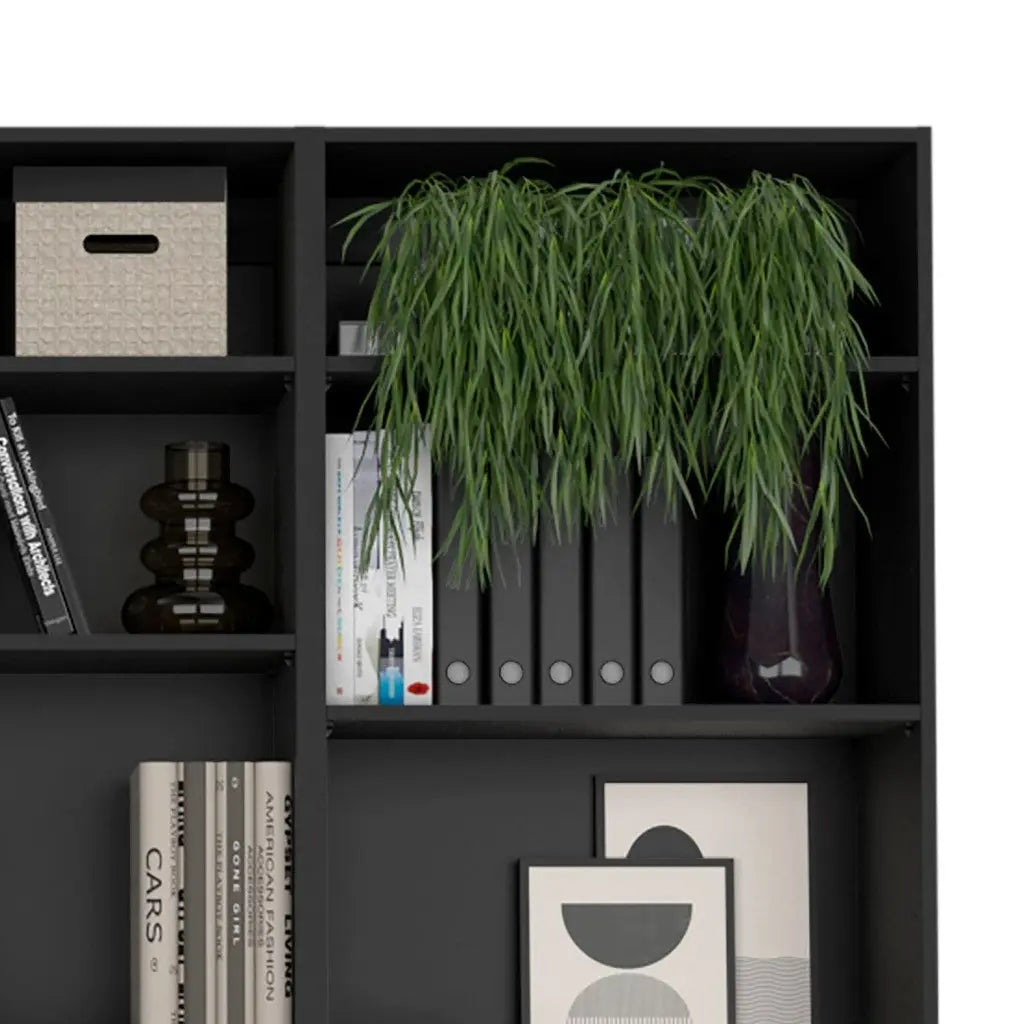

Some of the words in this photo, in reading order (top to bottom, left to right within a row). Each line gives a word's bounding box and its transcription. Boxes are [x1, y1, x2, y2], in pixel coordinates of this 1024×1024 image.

[7, 412, 18, 426] To
[19, 451, 47, 511] Mockingbird
[21, 517, 38, 542] with
[28, 541, 56, 597] Architects
[265, 791, 275, 903] AMERICAN
[146, 847, 162, 943] CARS
[265, 909, 275, 1001] FASHION
